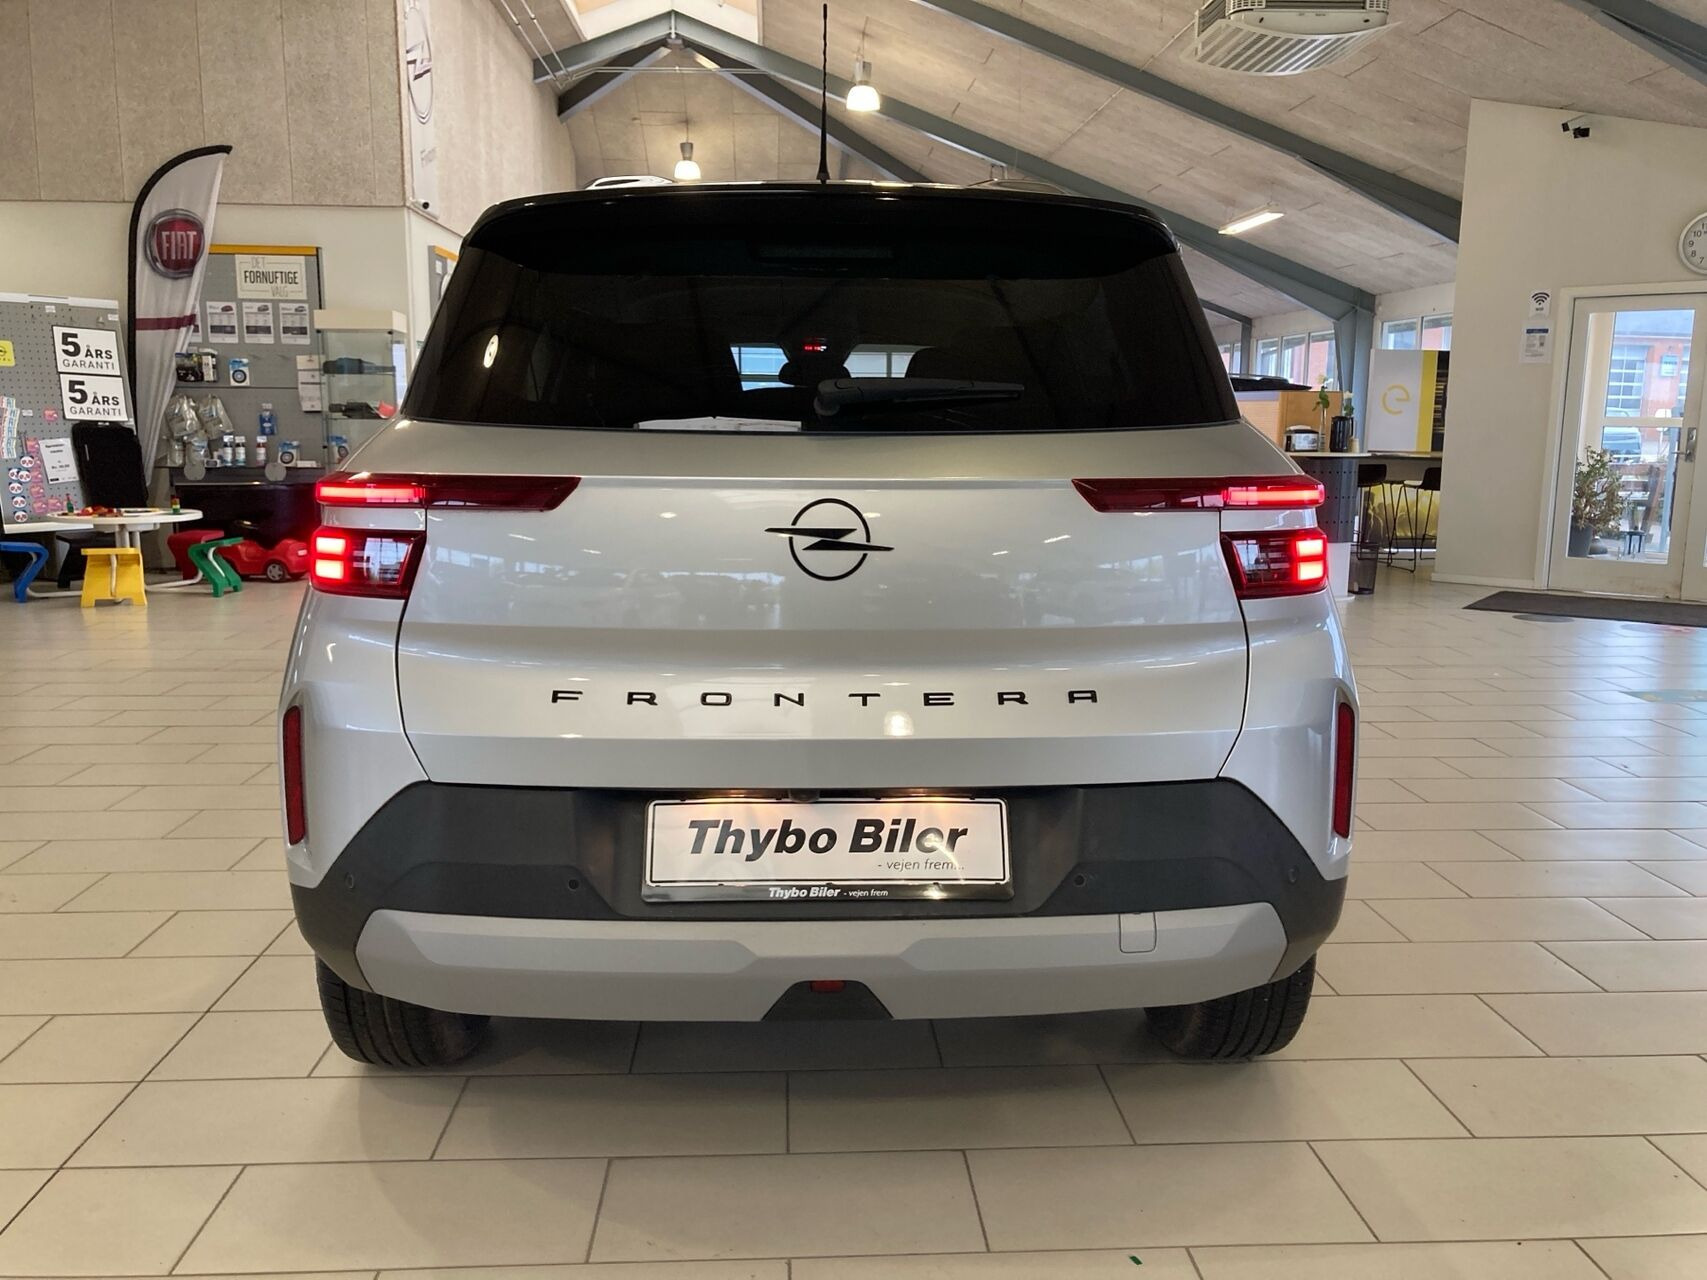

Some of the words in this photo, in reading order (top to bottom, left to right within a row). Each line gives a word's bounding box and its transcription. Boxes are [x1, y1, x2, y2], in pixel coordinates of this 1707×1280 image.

[1694, 230, 1702, 238] 10
[161, 231, 197, 260] FIAT
[1688, 240, 1695, 248] 9
[1691, 250, 1697, 258] 8
[243, 270, 299, 285] FORNUFTIGE
[61, 332, 82, 358] 5
[84, 344, 114, 360] ÅRS
[62, 358, 115, 371] GARANTI
[68, 380, 89, 405] 5
[91, 391, 120, 406] ÅRS
[69, 405, 122, 417] GARANTI
[550, 689, 1098, 708] FRONTERA
[688, 819, 838, 862] Thybo
[848, 818, 969, 854] Biler
[886, 860, 921, 872] vejen
[769, 887, 808, 899] Thybo
[809, 886, 841, 898] Biler
[848, 890, 869, 898] vejen
[870, 888, 889, 897] frem
